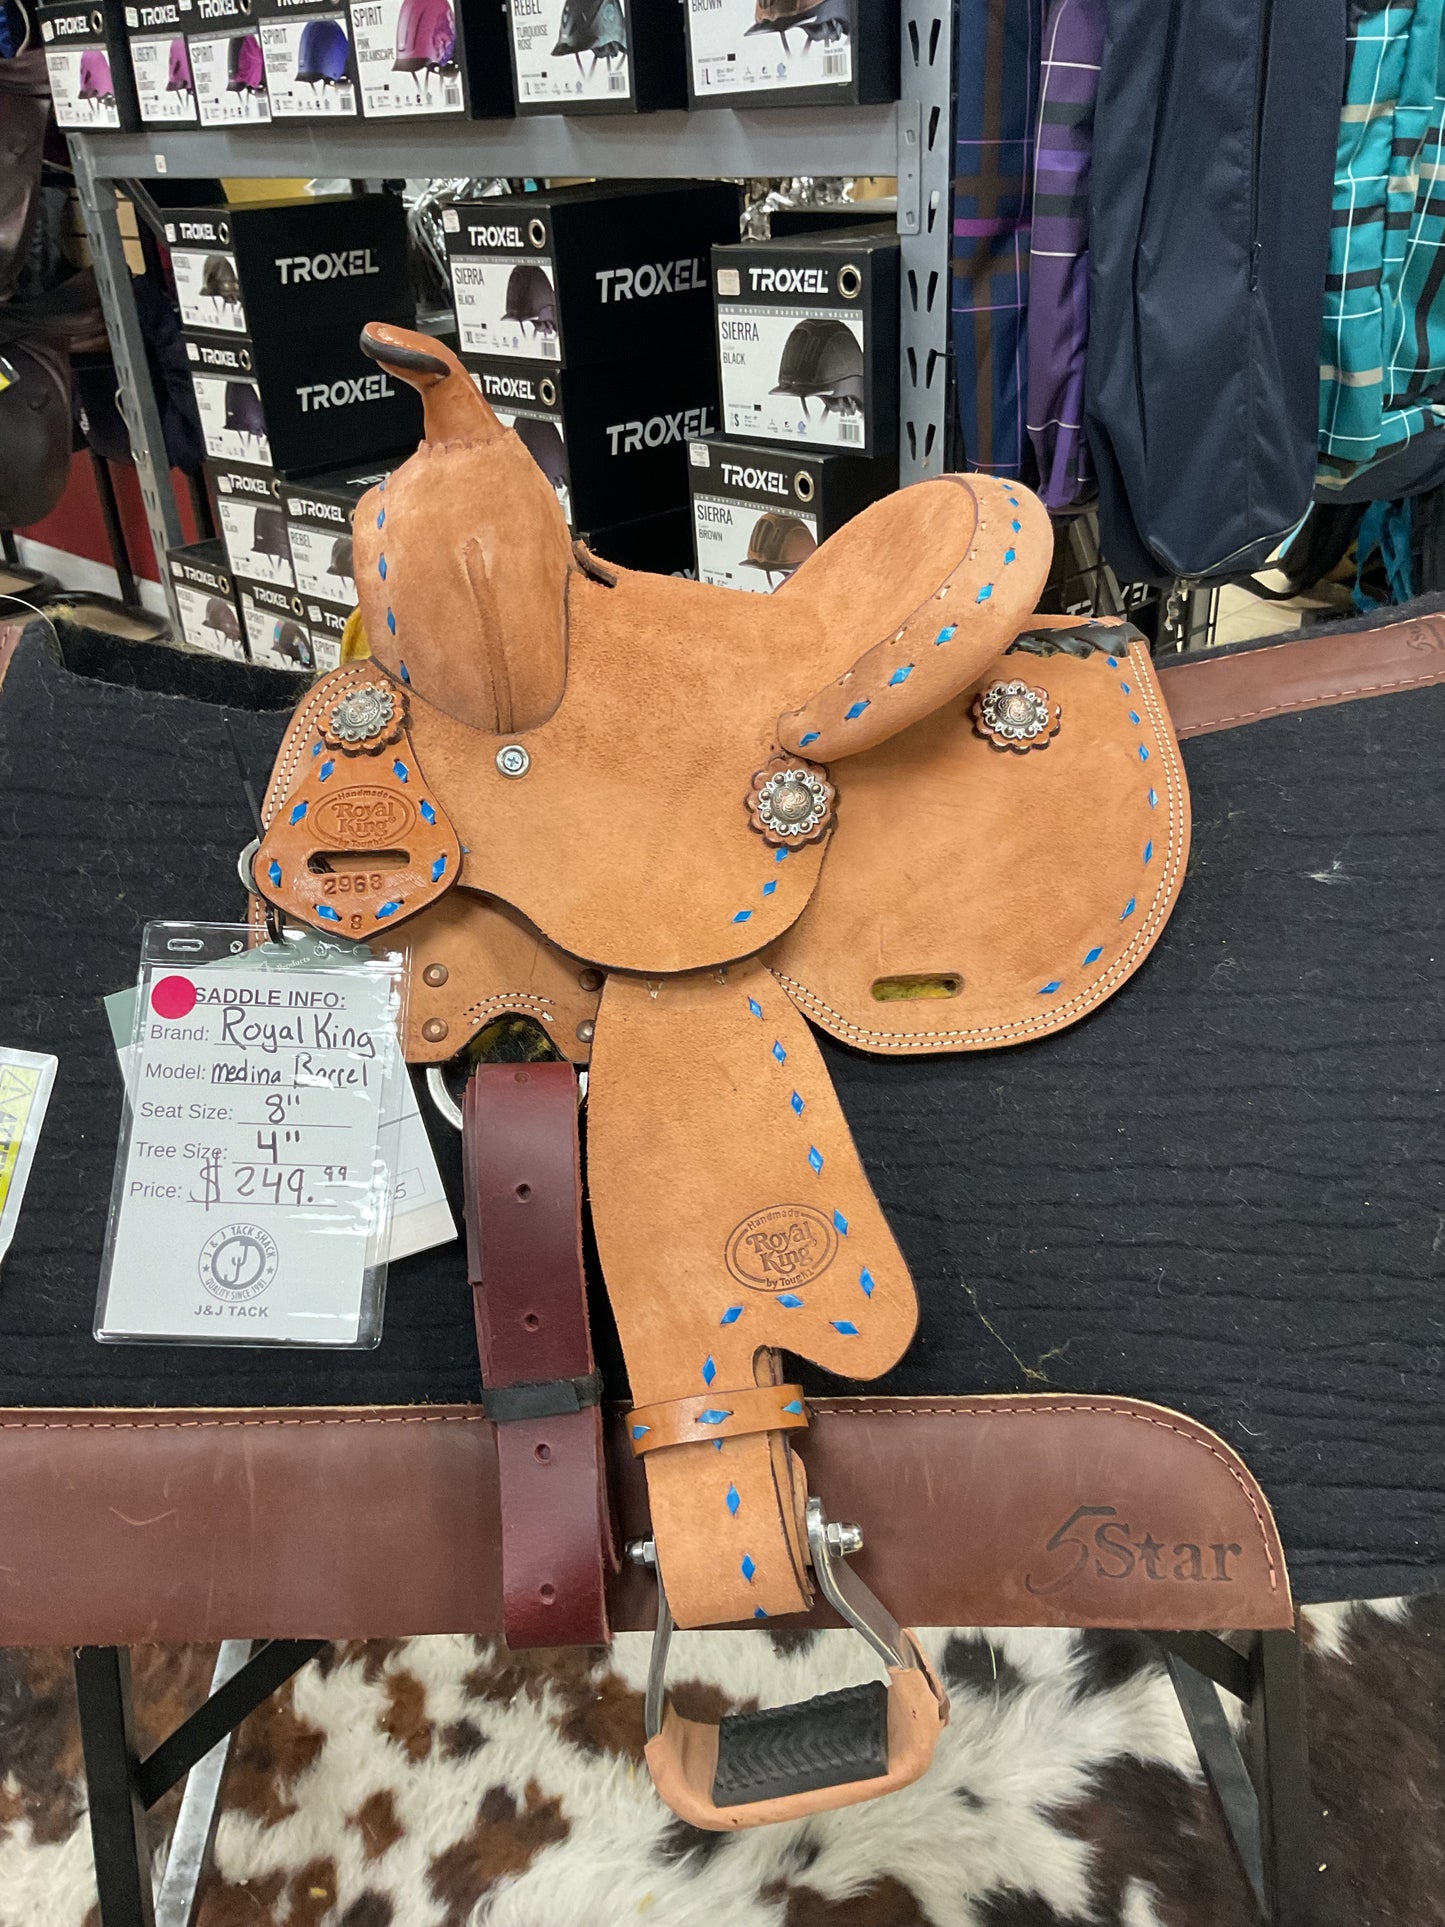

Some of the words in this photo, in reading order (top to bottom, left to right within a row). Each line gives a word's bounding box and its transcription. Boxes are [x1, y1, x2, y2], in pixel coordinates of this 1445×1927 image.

[140, 4, 180, 26] TROXEL
[198, 0, 238, 19] TROXEL
[353, 6, 383, 28] SPIRIT
[514, 0, 542, 16] REBEL
[54, 15, 90, 35] TROXEL
[262, 28, 287, 45] SPIRIT
[191, 45, 214, 63] SPIRIT
[179, 222, 217, 240] TROXEL
[468, 226, 524, 248] TROXEL
[275, 249, 380, 285] TROXEL
[454, 267, 485, 286] SIERRA
[595, 257, 707, 304] TROXEL
[748, 268, 829, 294] TROXEL
[458, 295, 476, 306] BLACK
[721, 321, 760, 342] SIERRA
[200, 347, 240, 368] TROXEL
[723, 352, 746, 365] BLACK
[296, 374, 395, 412] TROXEL
[483, 375, 536, 400] TROXEL
[606, 407, 715, 456] TROXEL
[227, 473, 271, 495] TROXEL
[721, 463, 789, 495] TROXEL
[301, 500, 346, 523] TROXEL
[697, 504, 733, 525] SIERRA
[290, 530, 312, 549] REBEL
[699, 528, 723, 542] BROWN
[183, 565, 220, 588] TROXEL
[253, 586, 290, 610] TROXEL
[337, 790, 388, 801] Handmade
[331, 802, 394, 821] Royal
[338, 819, 388, 838] King
[350, 914, 363, 930] 8
[196, 987, 281, 1006] SADDLE
[289, 991, 346, 1008] INFO:
[151, 1024, 210, 1042] Brand:
[222, 1006, 304, 1053] Royal
[314, 1012, 376, 1058] King
[146, 1063, 206, 1080] Model:
[141, 1102, 183, 1119] Seat
[188, 1104, 233, 1120] Size:
[137, 1142, 177, 1158] Tree
[183, 1143, 228, 1160] Size:
[130, 1182, 182, 1199] Price:
[747, 1209, 800, 1231] Handmade
[231, 1225, 255, 1236] TACK
[255, 1231, 276, 1258] SHACK
[746, 1221, 814, 1254] Royal
[760, 1244, 813, 1274] King
[766, 1278, 778, 1288] by
[194, 1305, 224, 1317] J&J
[228, 1306, 270, 1318] TACK
